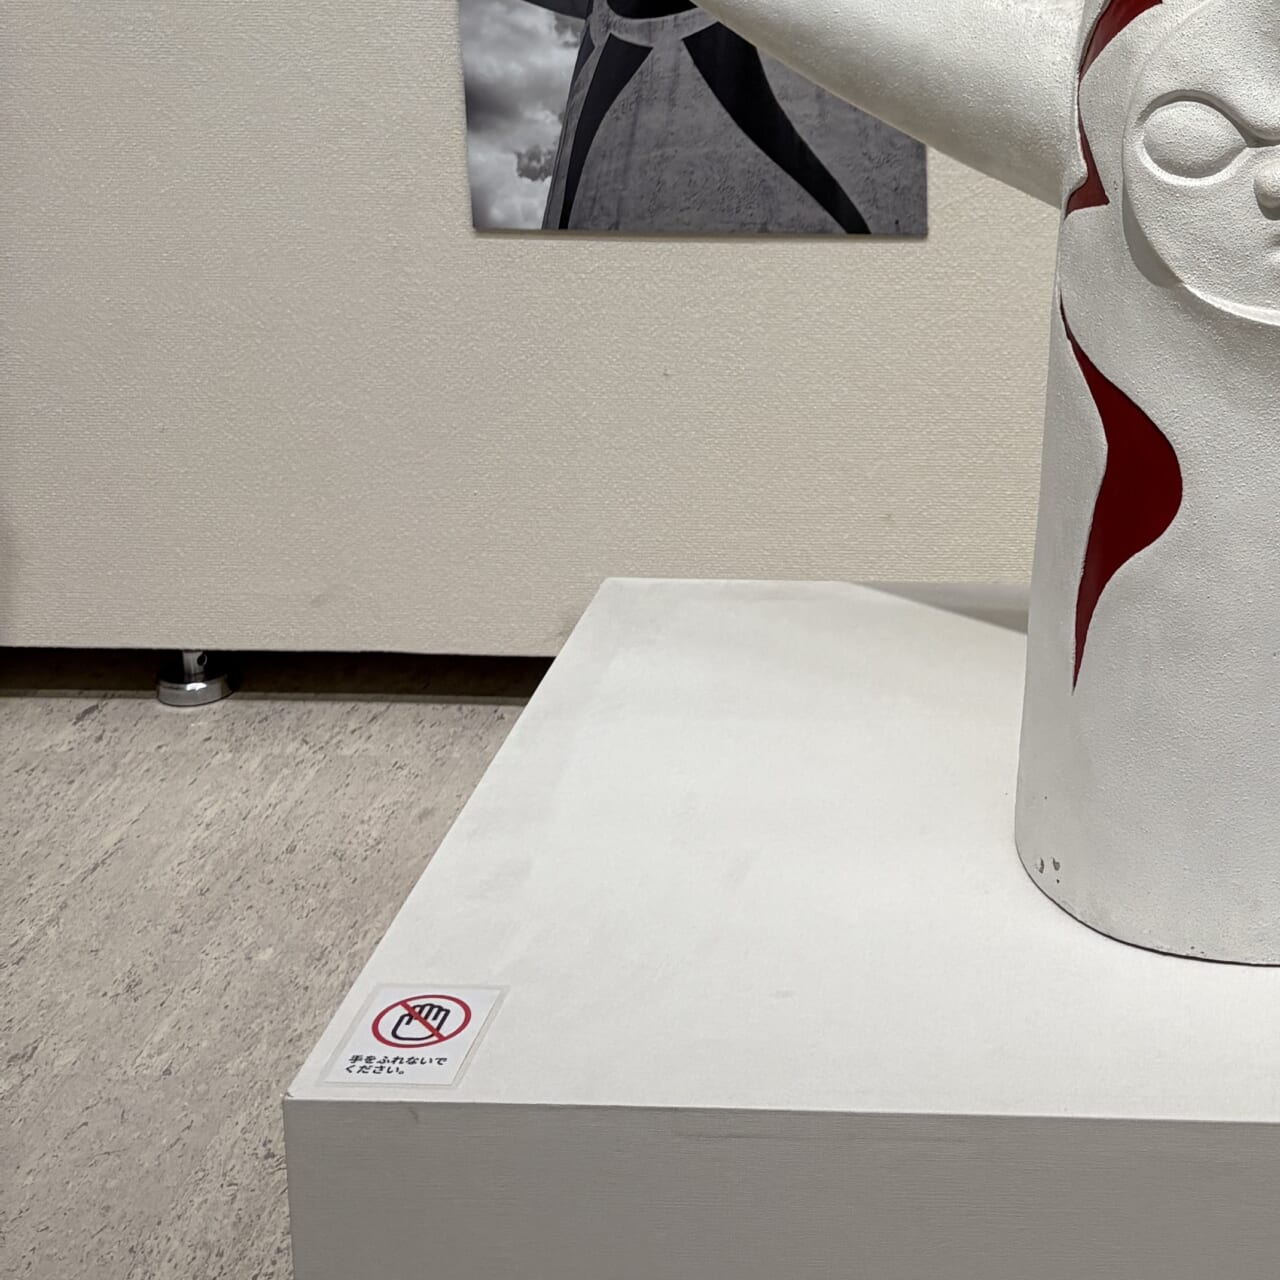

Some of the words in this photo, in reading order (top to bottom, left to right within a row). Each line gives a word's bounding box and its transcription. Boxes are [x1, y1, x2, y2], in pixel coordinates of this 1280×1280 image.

[348, 1055, 448, 1065] 手をふれないで
[346, 1065, 405, 1074] ください。
